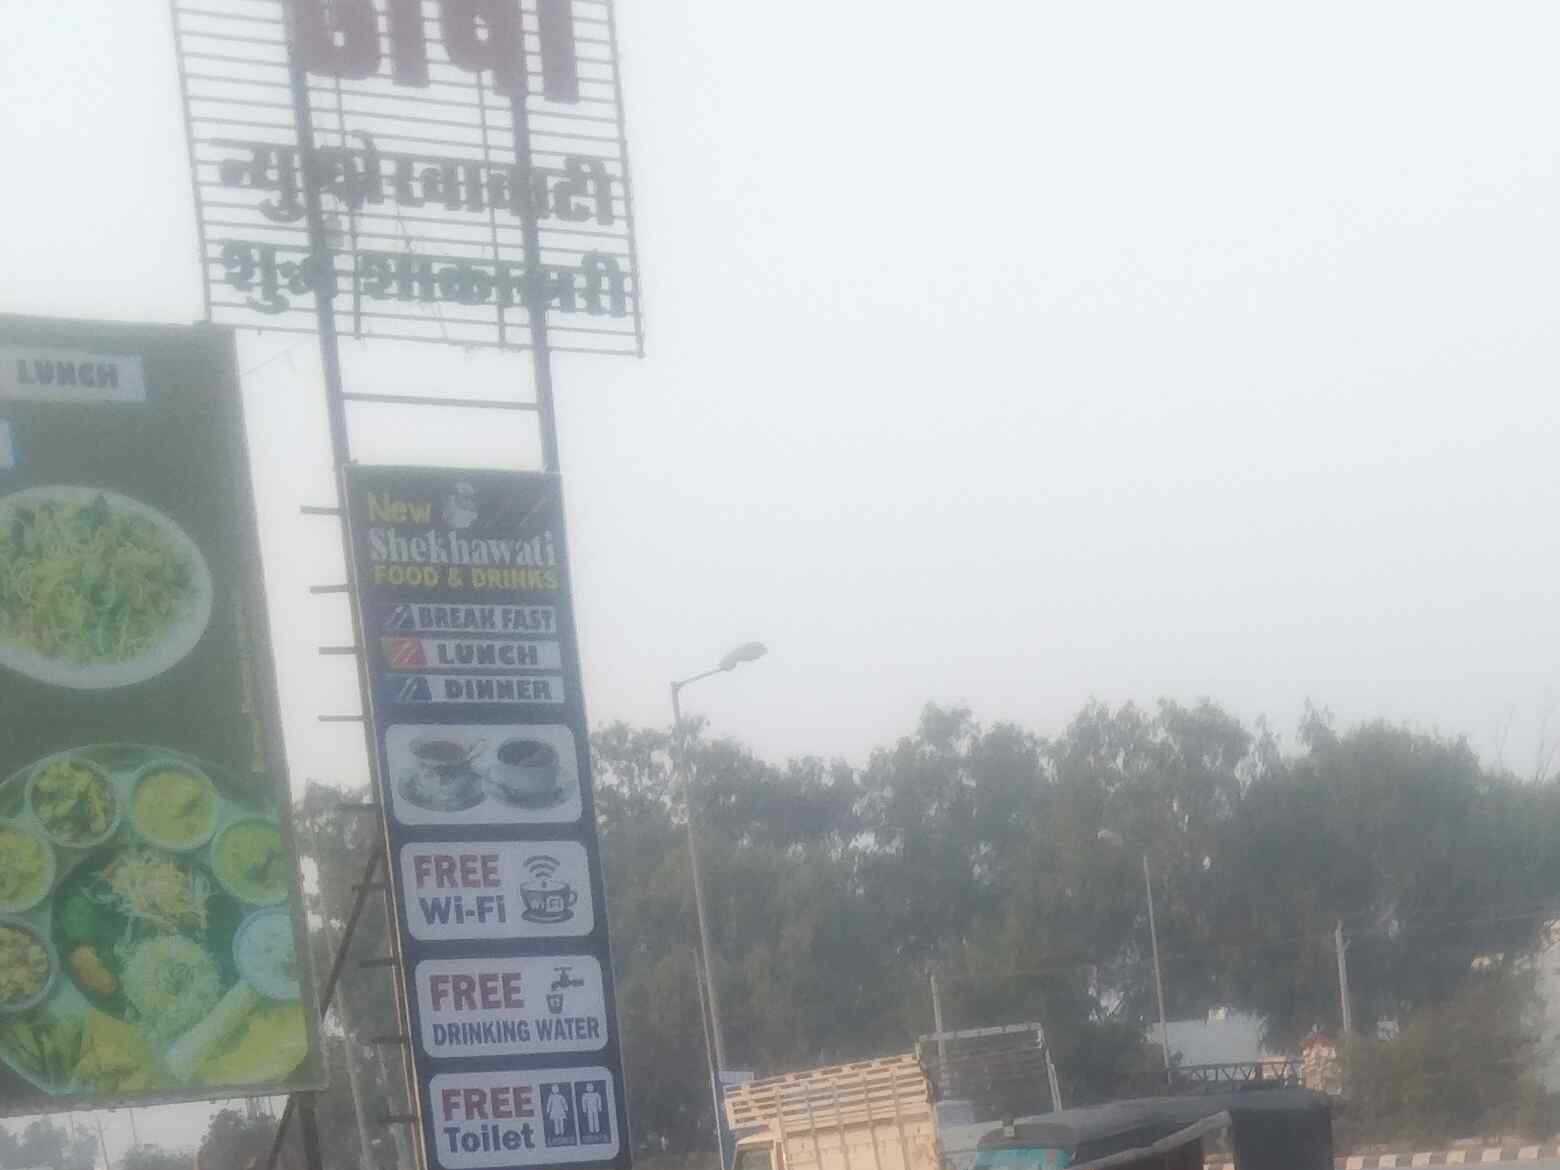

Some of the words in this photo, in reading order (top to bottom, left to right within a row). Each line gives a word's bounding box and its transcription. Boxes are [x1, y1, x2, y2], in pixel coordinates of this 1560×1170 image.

[16, 359, 120, 388] LUNCH
[367, 490, 432, 524] New
[367, 527, 558, 567] Shekhawati
[374, 564, 439, 585] FOOD
[447, 568, 464, 589] &
[472, 566, 560, 592] DRINKS
[418, 606, 496, 630] BREAK
[502, 608, 553, 632] FAST
[437, 643, 539, 665] LUNCH
[445, 679, 553, 699] DINNER
[413, 855, 501, 888] FREE
[418, 896, 506, 924] Wi-Fi
[430, 972, 525, 1011] FREE
[432, 1018, 531, 1046] DRINKING
[535, 1016, 600, 1042] WATER
[441, 1086, 535, 1121] FREE
[443, 1121, 536, 1153] Toilet
